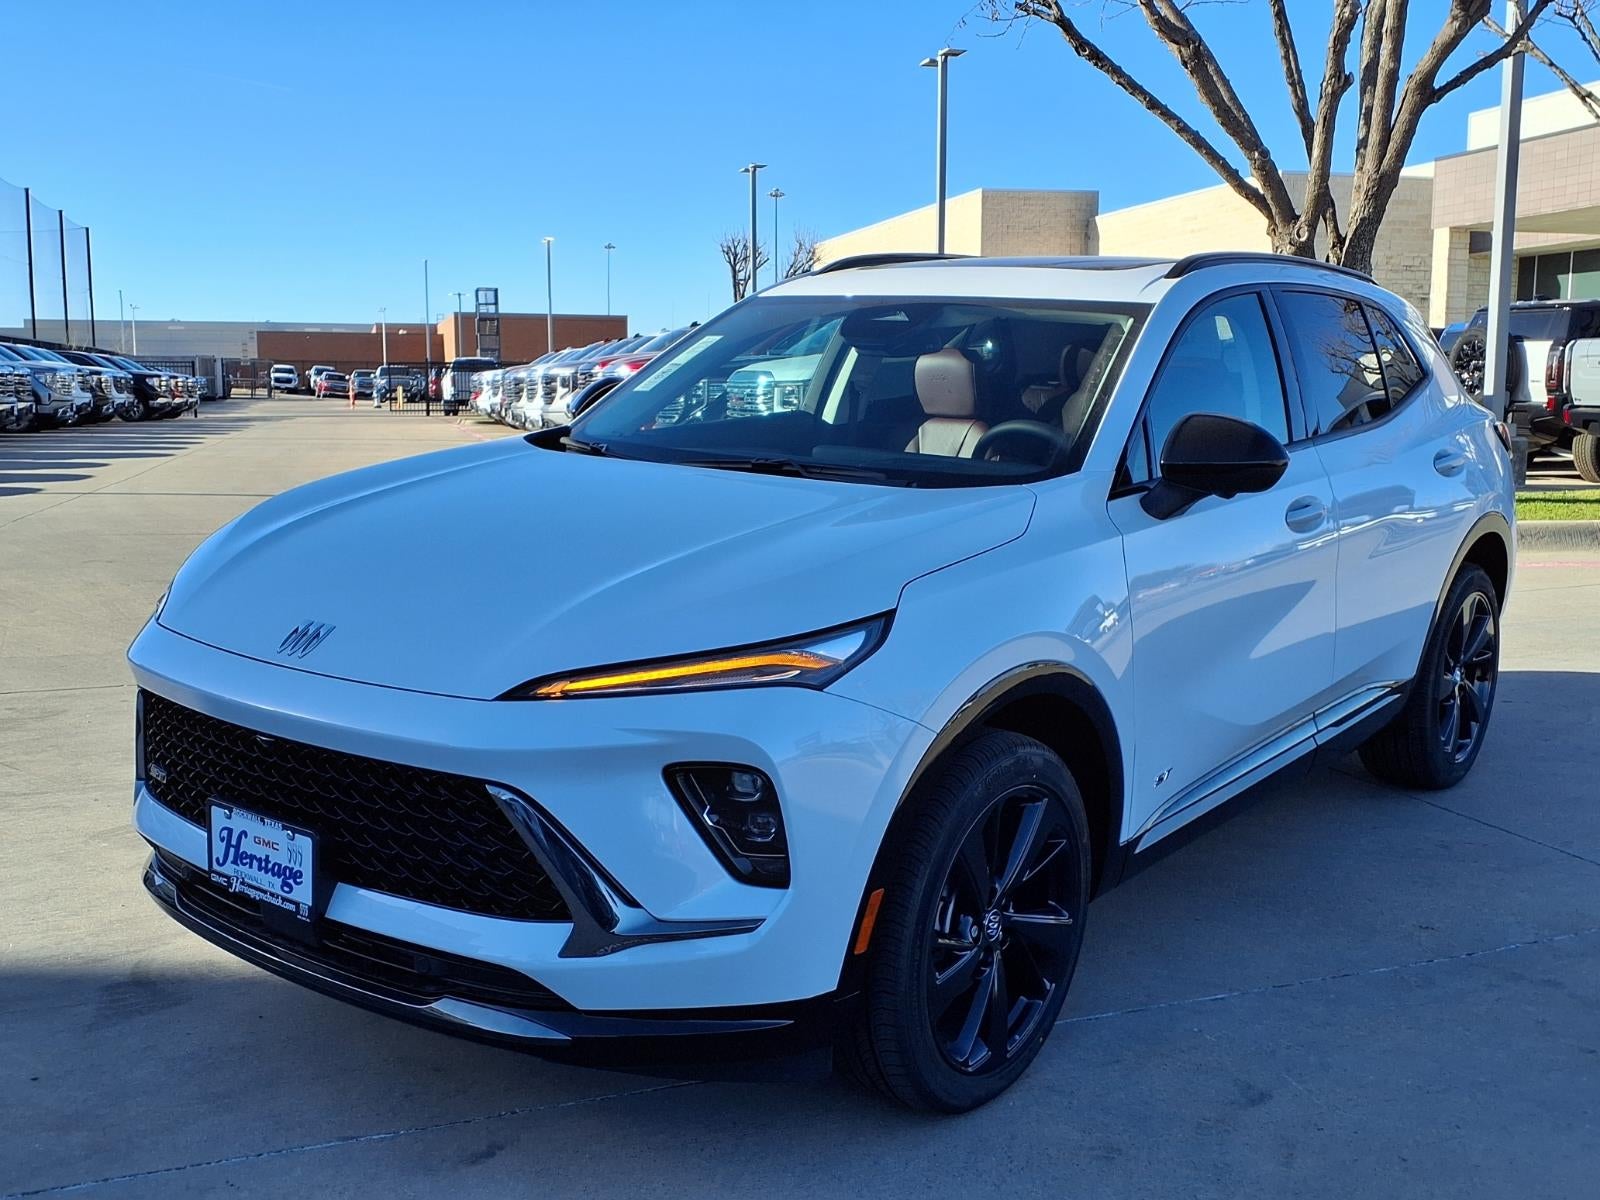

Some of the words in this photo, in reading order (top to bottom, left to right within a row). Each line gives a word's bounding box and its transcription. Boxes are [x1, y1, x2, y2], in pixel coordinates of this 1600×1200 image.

[253, 836, 280, 851] GMC
[215, 826, 304, 894] Heritage
[210, 873, 228, 886] GMC
